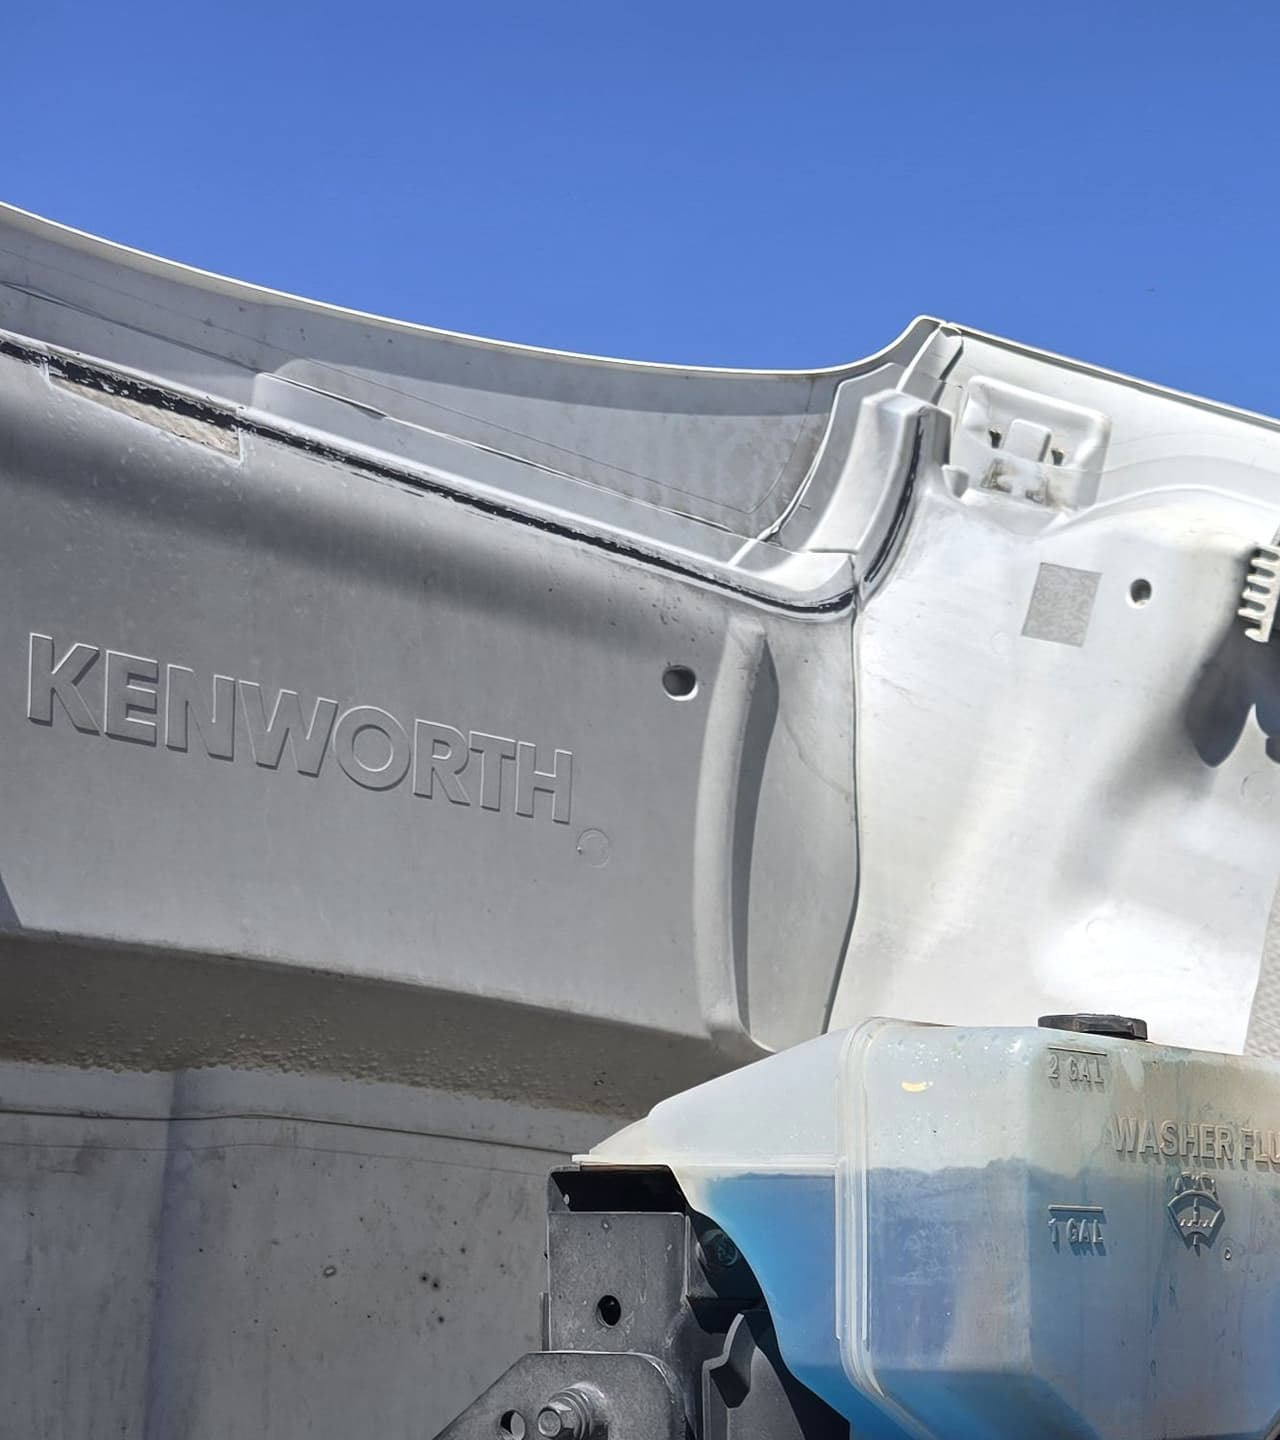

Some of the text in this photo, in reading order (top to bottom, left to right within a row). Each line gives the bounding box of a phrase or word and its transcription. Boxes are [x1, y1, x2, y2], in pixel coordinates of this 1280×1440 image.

[27, 631, 573, 825] KENWORTH
[1048, 1055, 1105, 1084] 2 GAL
[1110, 1113, 1234, 1161] WASHER
[1048, 1218, 1104, 1245] 1 GAL
